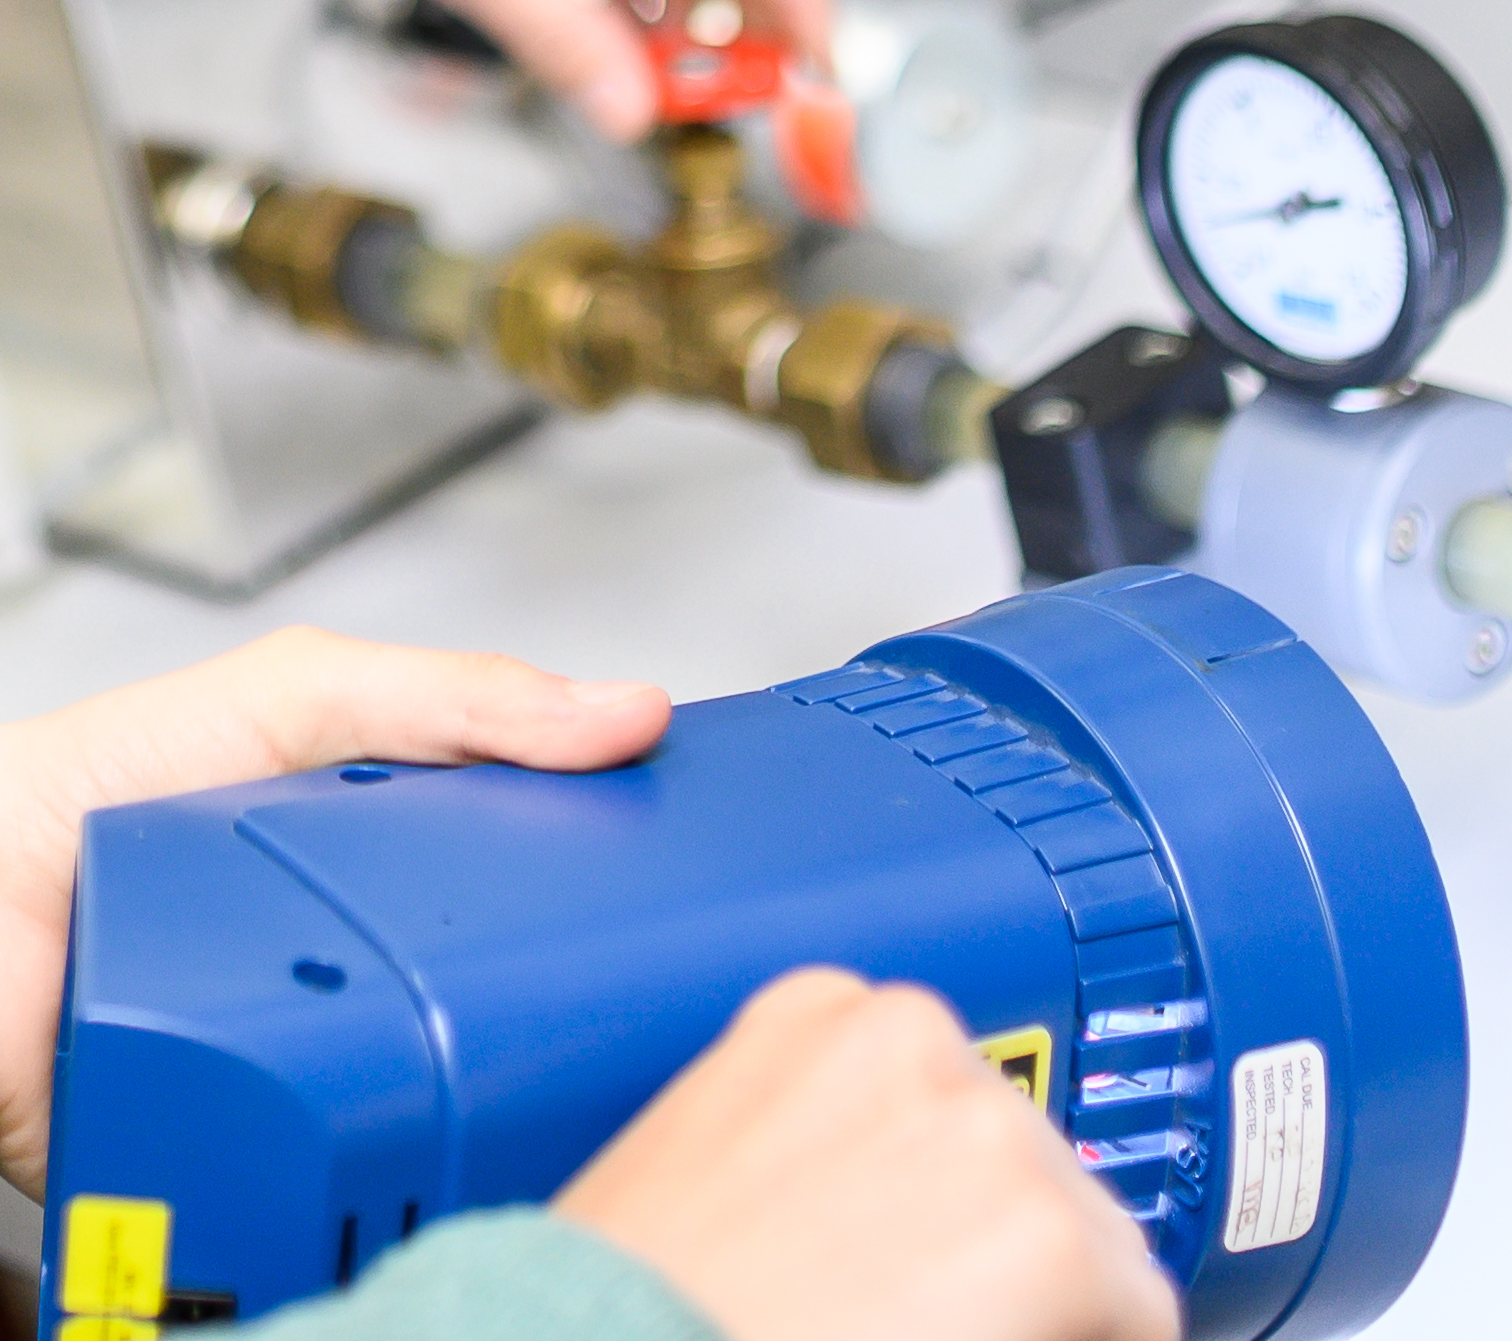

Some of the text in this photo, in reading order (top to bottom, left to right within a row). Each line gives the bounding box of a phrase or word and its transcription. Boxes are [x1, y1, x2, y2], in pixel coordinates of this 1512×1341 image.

[1263, 1065, 1275, 1115] TESTED
[1281, 1060, 1293, 1096] TECH
[1300, 1056, 1313, 1111] CAL DUE
[1244, 1069, 1256, 1140] INSPECTED
